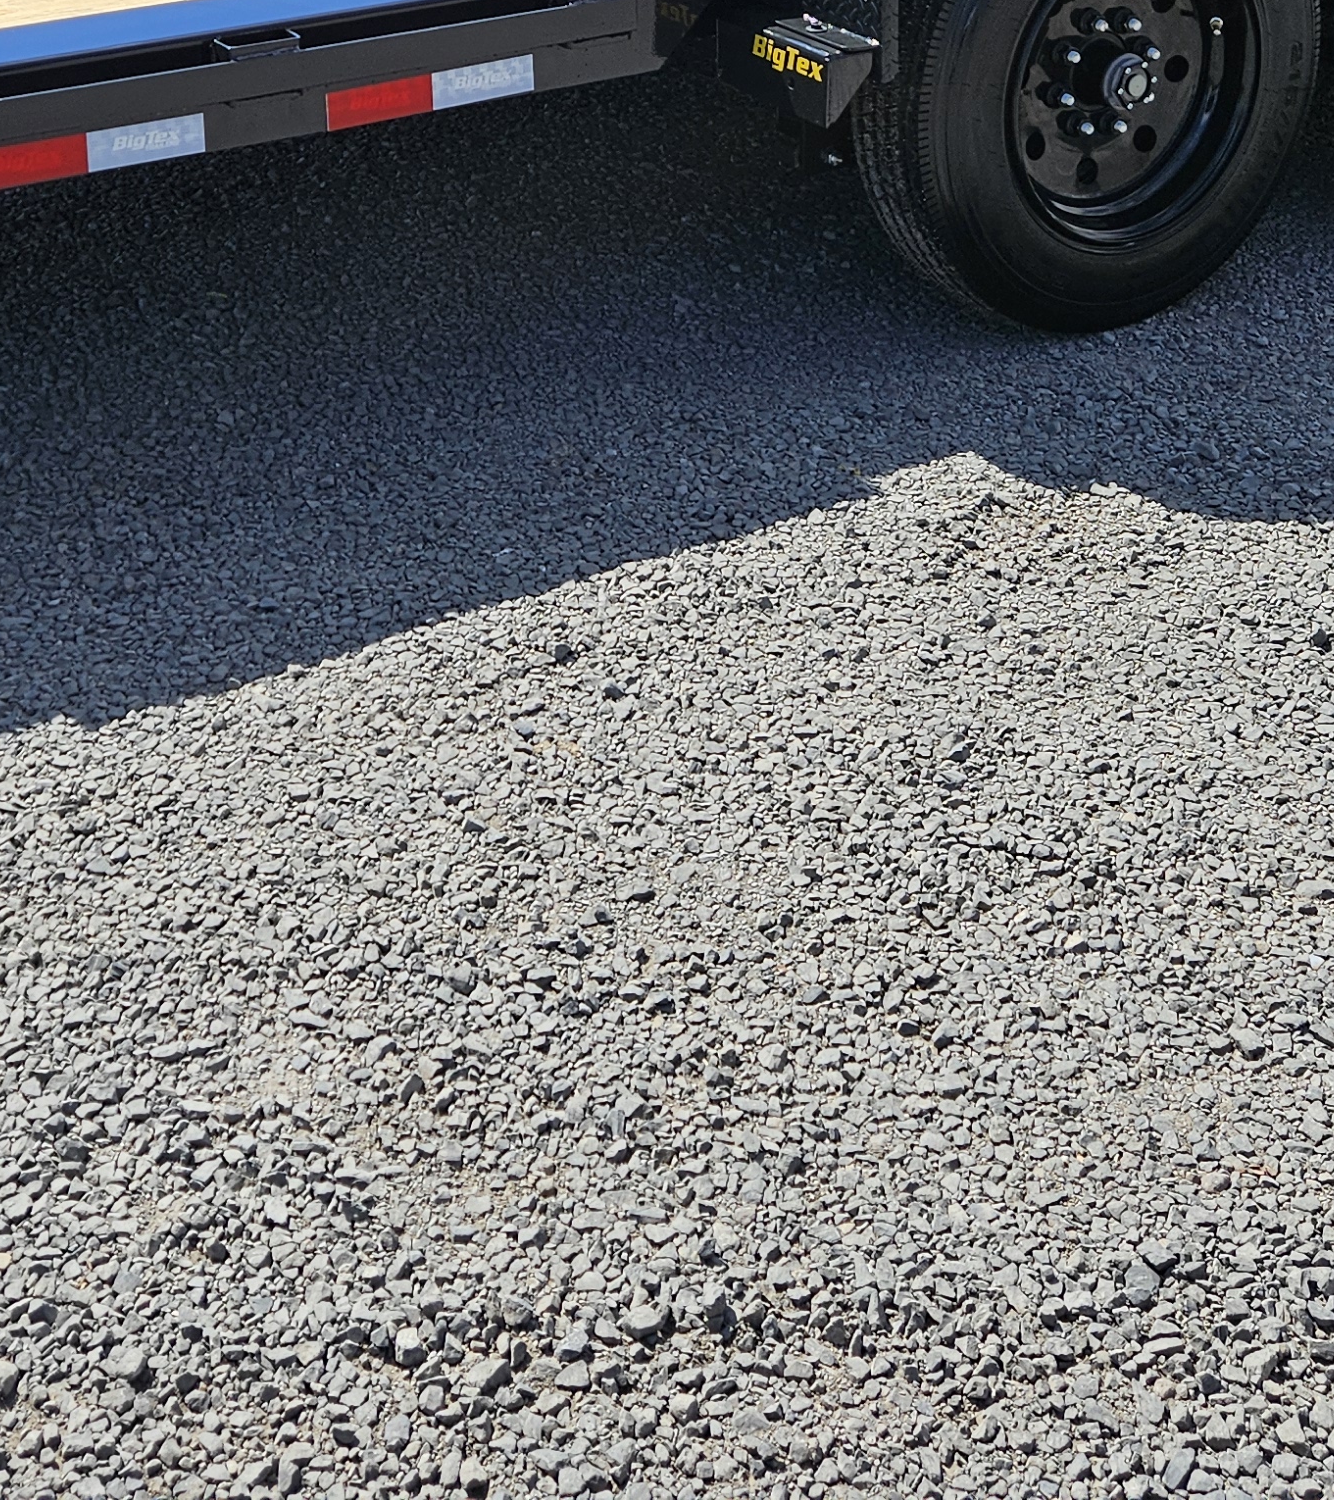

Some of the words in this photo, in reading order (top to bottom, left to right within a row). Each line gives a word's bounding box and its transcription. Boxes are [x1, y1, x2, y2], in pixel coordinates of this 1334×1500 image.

[751, 33, 825, 83] BigTex
[454, 69, 512, 91] BigTex
[111, 128, 181, 152] BigTex
